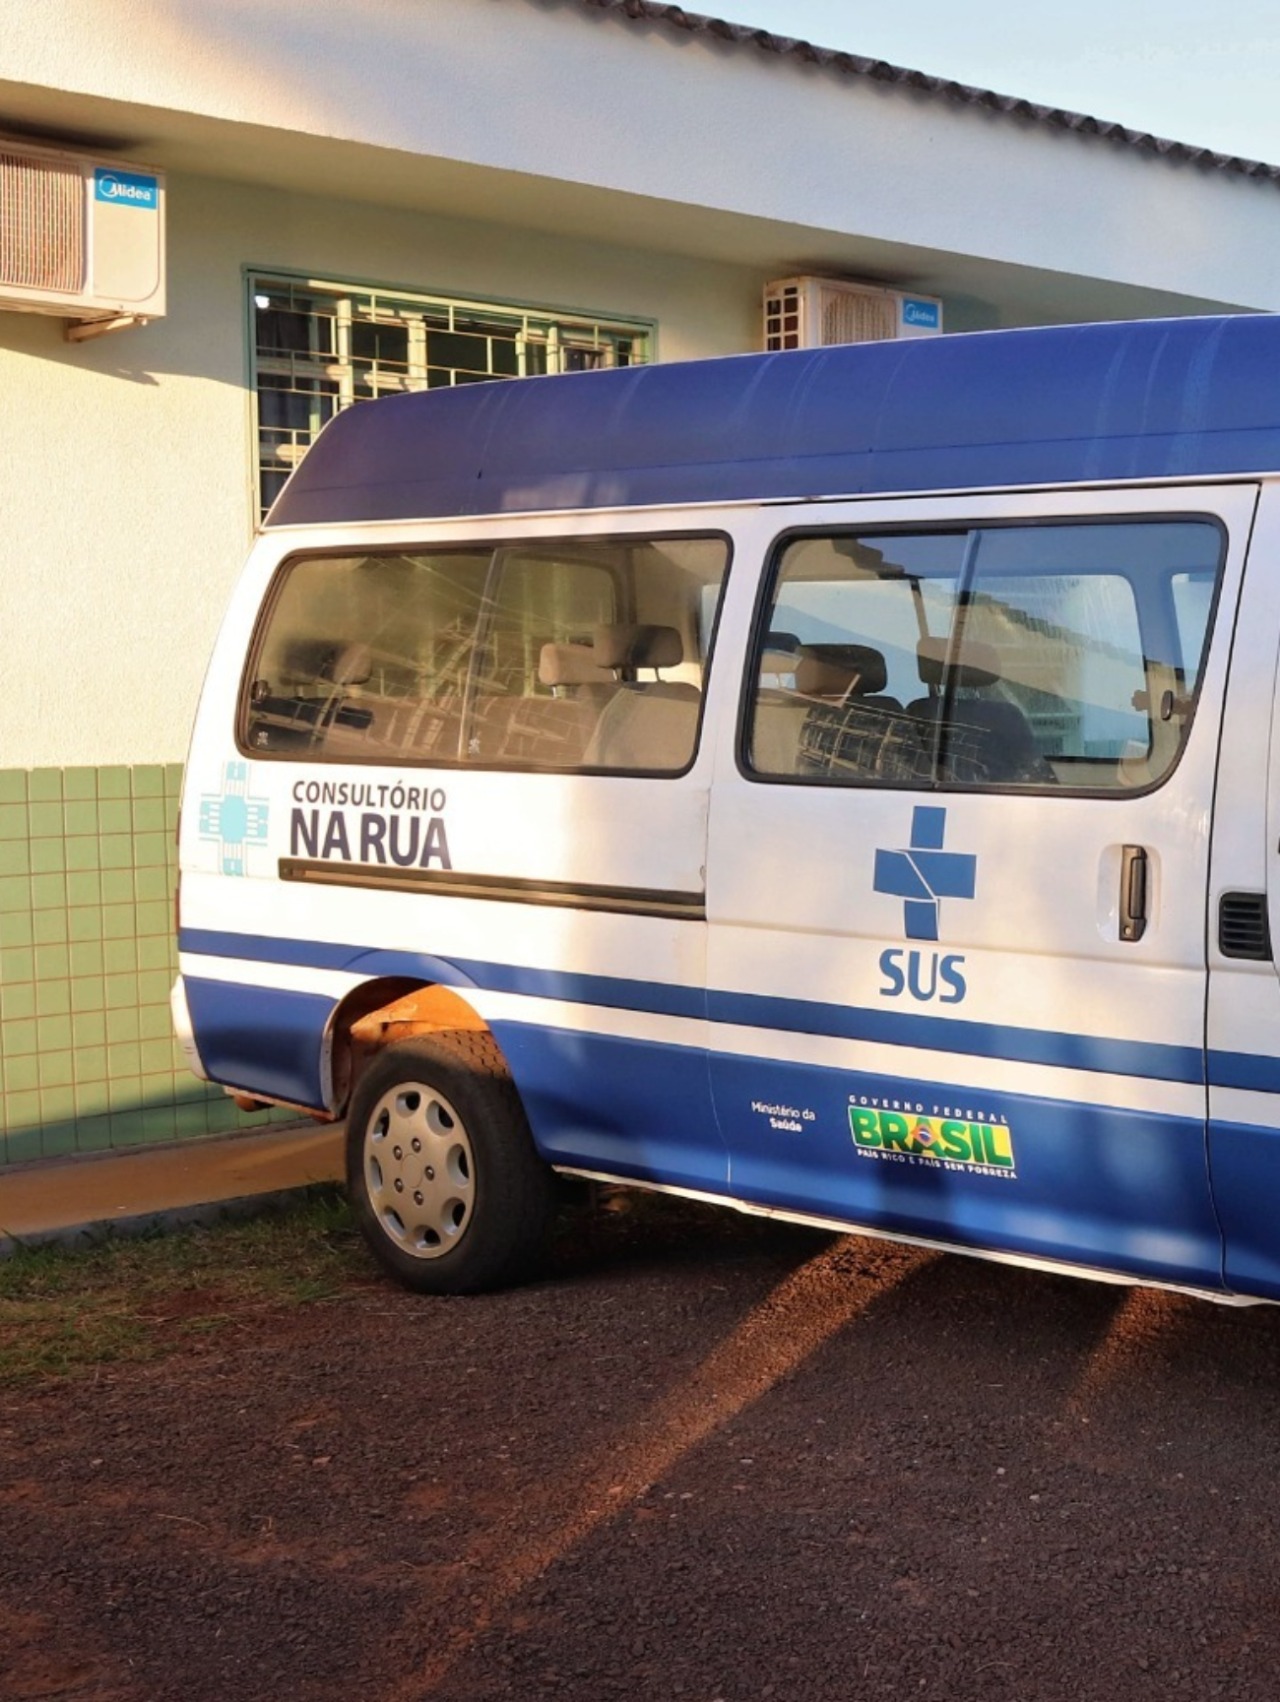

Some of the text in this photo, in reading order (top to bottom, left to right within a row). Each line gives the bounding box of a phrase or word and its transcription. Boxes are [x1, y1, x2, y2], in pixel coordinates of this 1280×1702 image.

[99, 175, 151, 201] Midea
[293, 780, 446, 812] CONSULTÓRIO
[290, 808, 452, 869] NA RUA
[879, 948, 966, 1004] SUS
[751, 1101, 816, 1121] Ministério da
[849, 1095, 1008, 1124] GOVERNO FEDERAL
[851, 1108, 1014, 1167] BRASIL
[944, 1161, 965, 1172] SEM
[968, 1165, 1017, 1179] POBREZA
